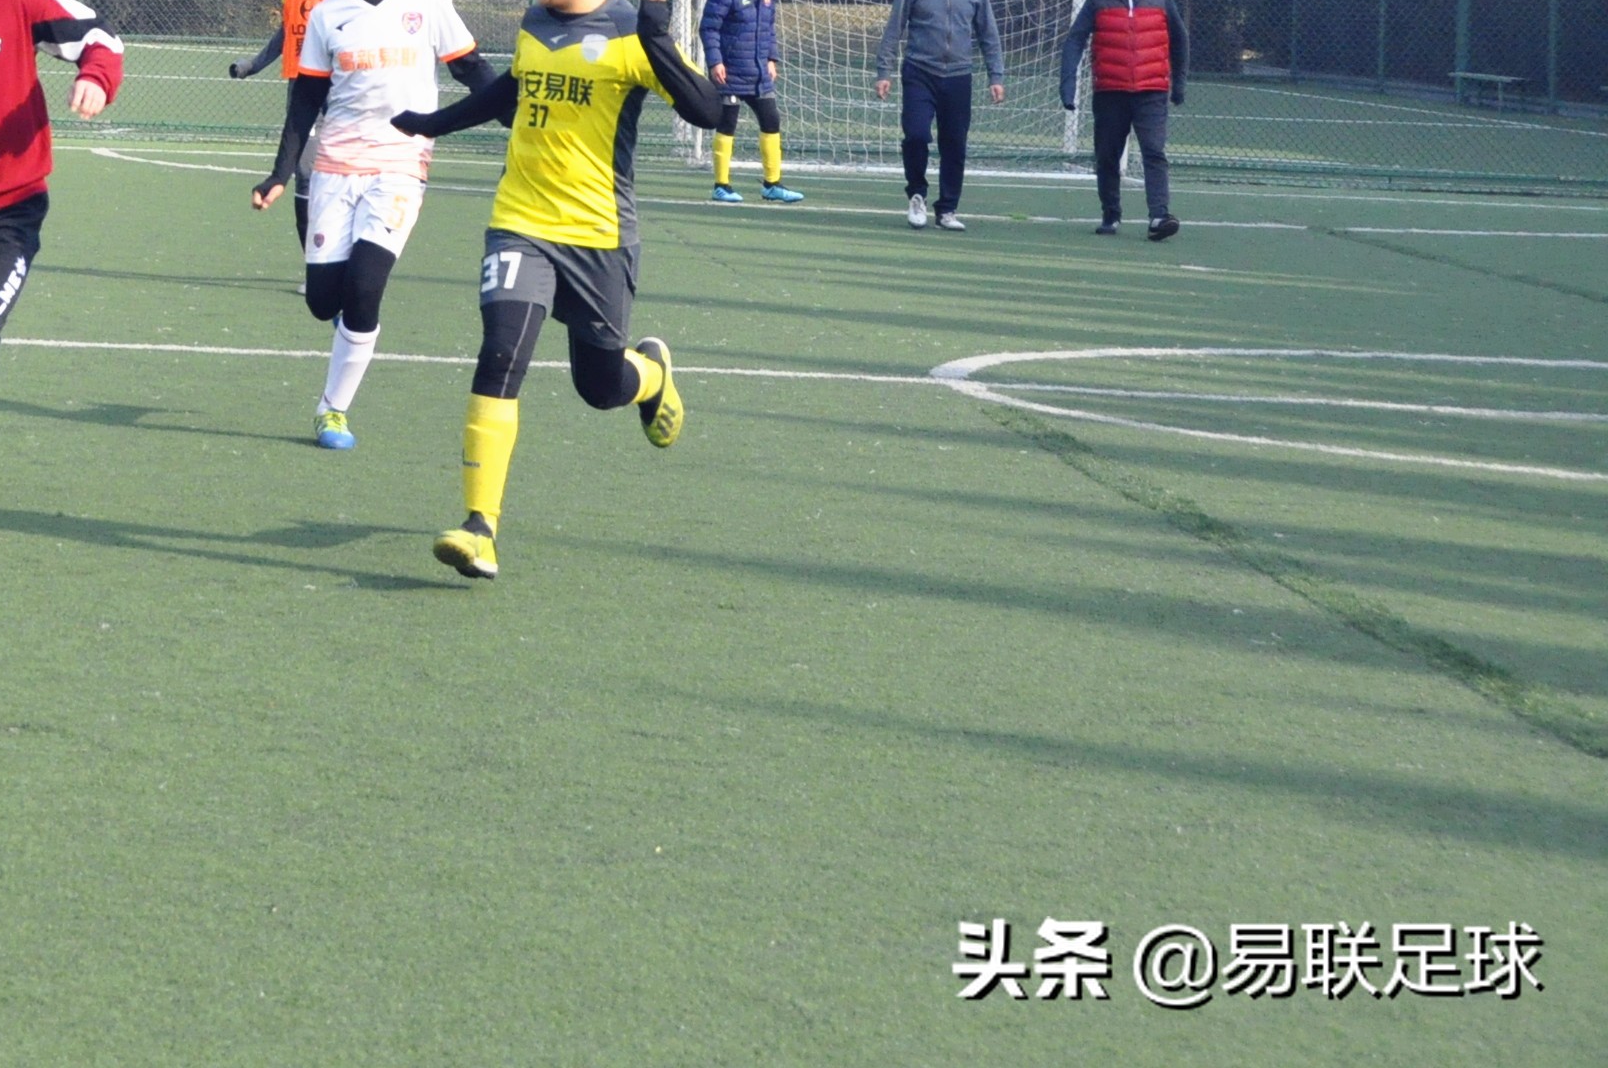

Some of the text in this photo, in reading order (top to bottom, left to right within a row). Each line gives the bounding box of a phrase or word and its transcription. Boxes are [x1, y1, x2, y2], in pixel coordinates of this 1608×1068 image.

[520, 70, 594, 107] 安易联
[528, 103, 550, 129] 37
[481, 251, 523, 293] 37
